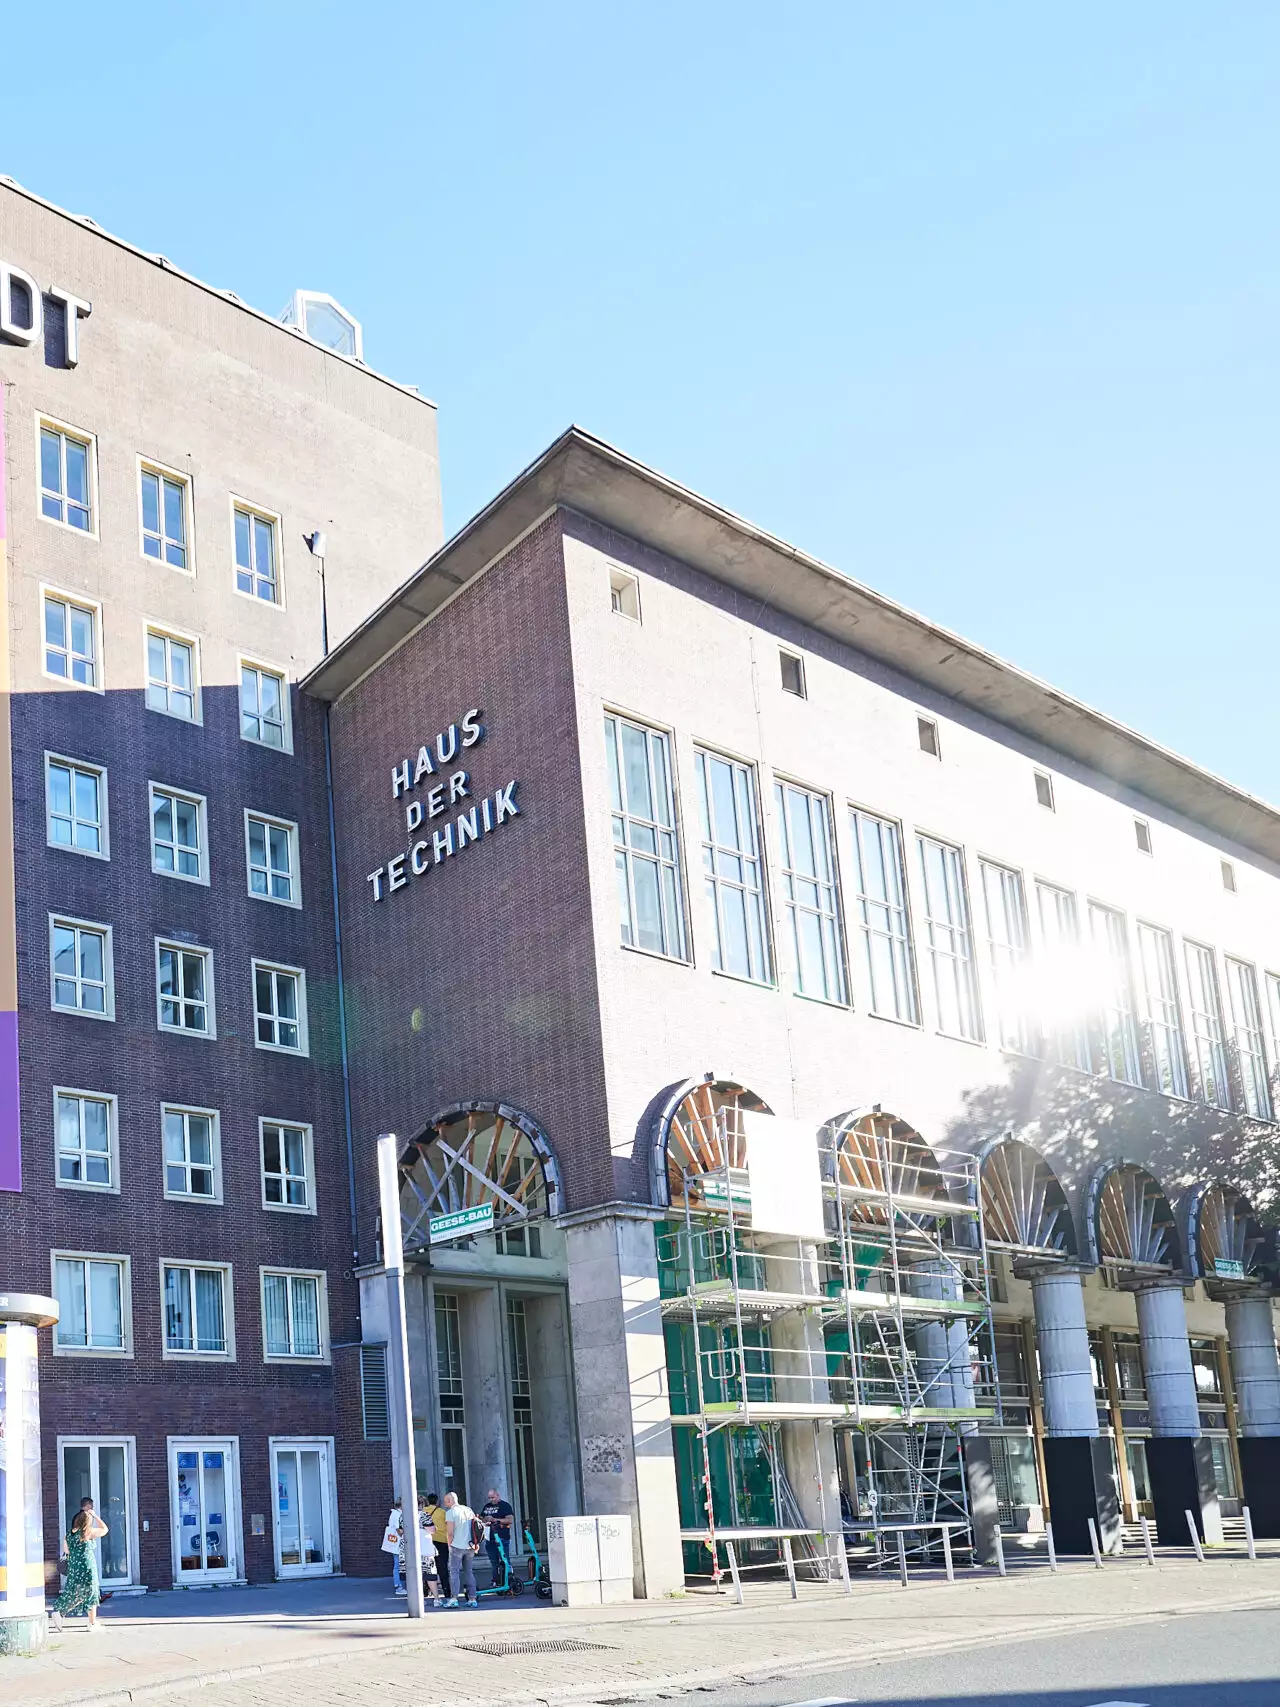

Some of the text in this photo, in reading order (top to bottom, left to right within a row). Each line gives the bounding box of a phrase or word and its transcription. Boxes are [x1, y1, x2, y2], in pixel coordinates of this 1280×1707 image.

[391, 708, 483, 799] HAUS
[405, 769, 469, 833] DER
[366, 779, 521, 902] TECHNIK
[431, 1207, 493, 1232] GEESE-BAU
